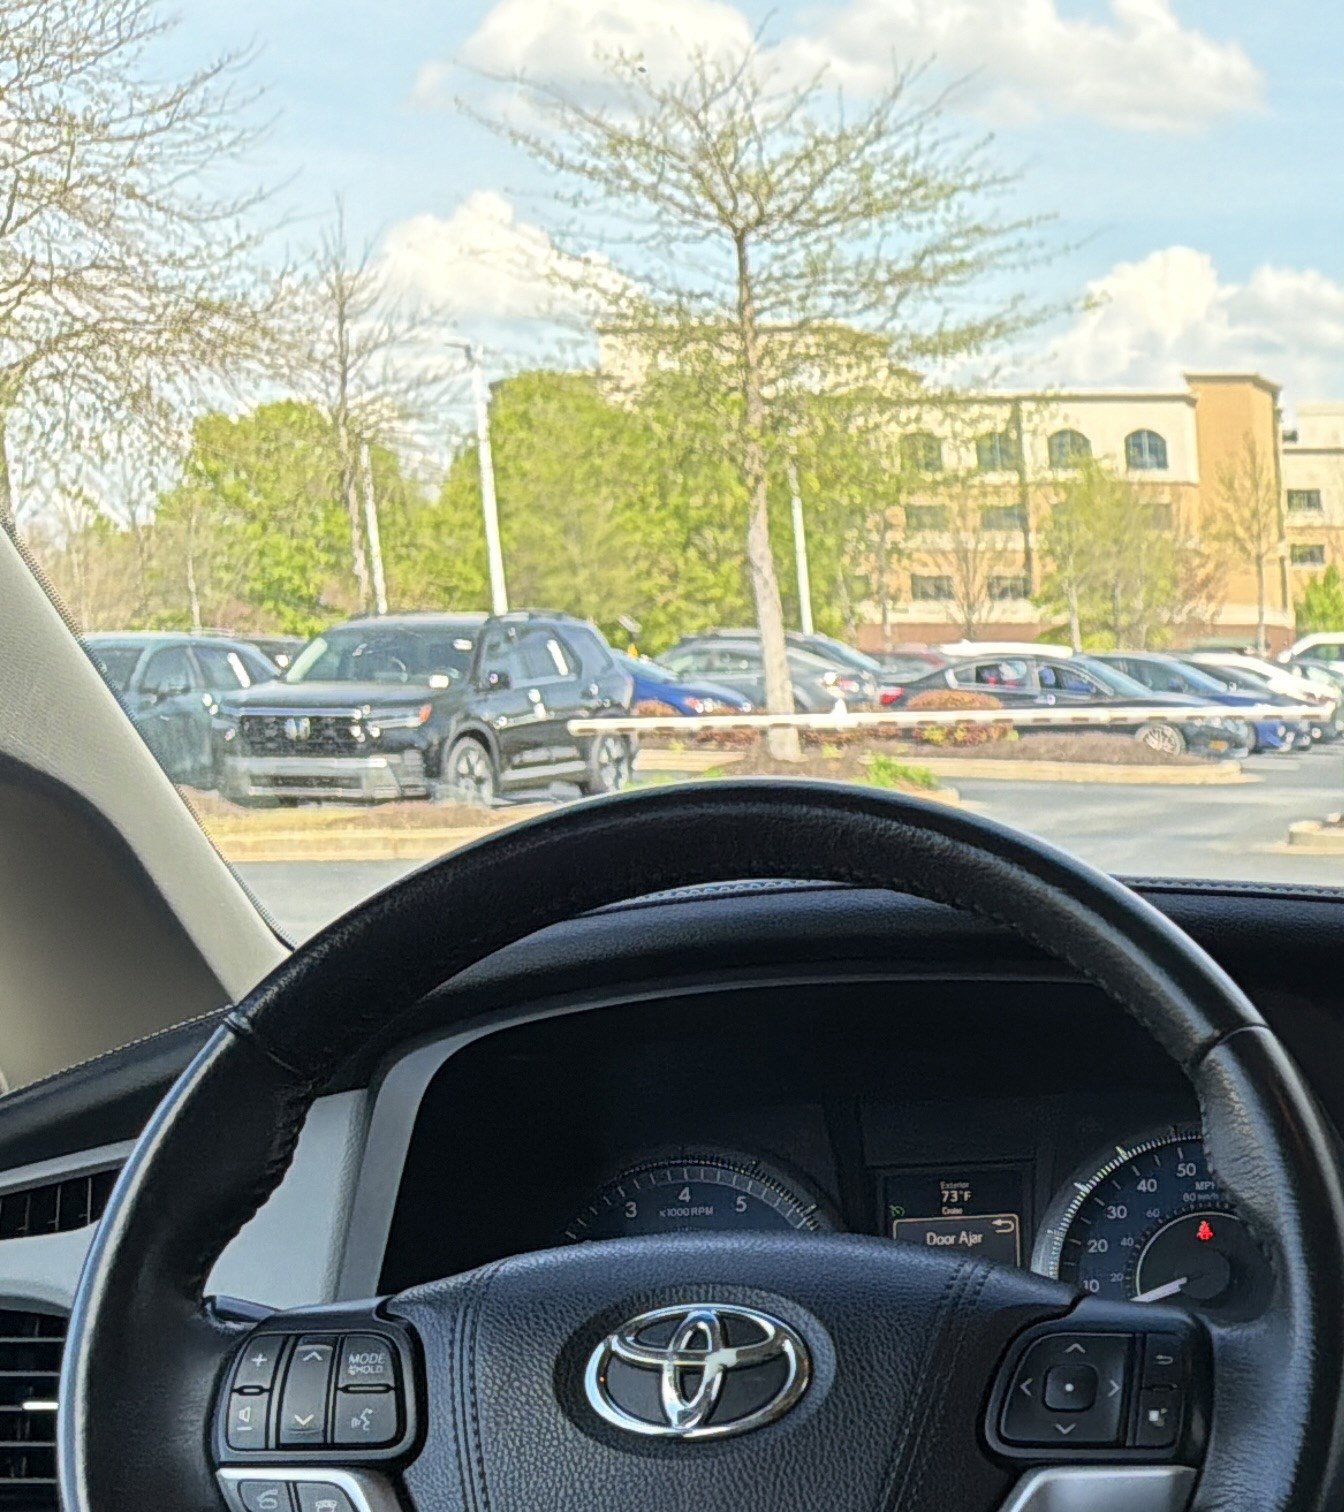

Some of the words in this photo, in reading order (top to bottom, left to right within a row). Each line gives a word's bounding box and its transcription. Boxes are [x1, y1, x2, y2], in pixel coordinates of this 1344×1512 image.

[1176, 1163, 1196, 1177] 50
[1137, 1179, 1158, 1193] 40
[678, 1187, 691, 1203] 4
[625, 1201, 637, 1218] 3
[735, 1196, 747, 1212] 5
[691, 1206, 714, 1217] RPM
[1106, 1205, 1128, 1219] 30
[1146, 1208, 1160, 1218] 60
[926, 1232, 956, 1246] Door
[959, 1231, 983, 1247] Ajar
[1087, 1239, 1108, 1253] 20
[1120, 1237, 1134, 1247] 40
[1110, 1272, 1124, 1282] 20
[1082, 1279, 1100, 1293] 10
[349, 1353, 386, 1365] MODE
